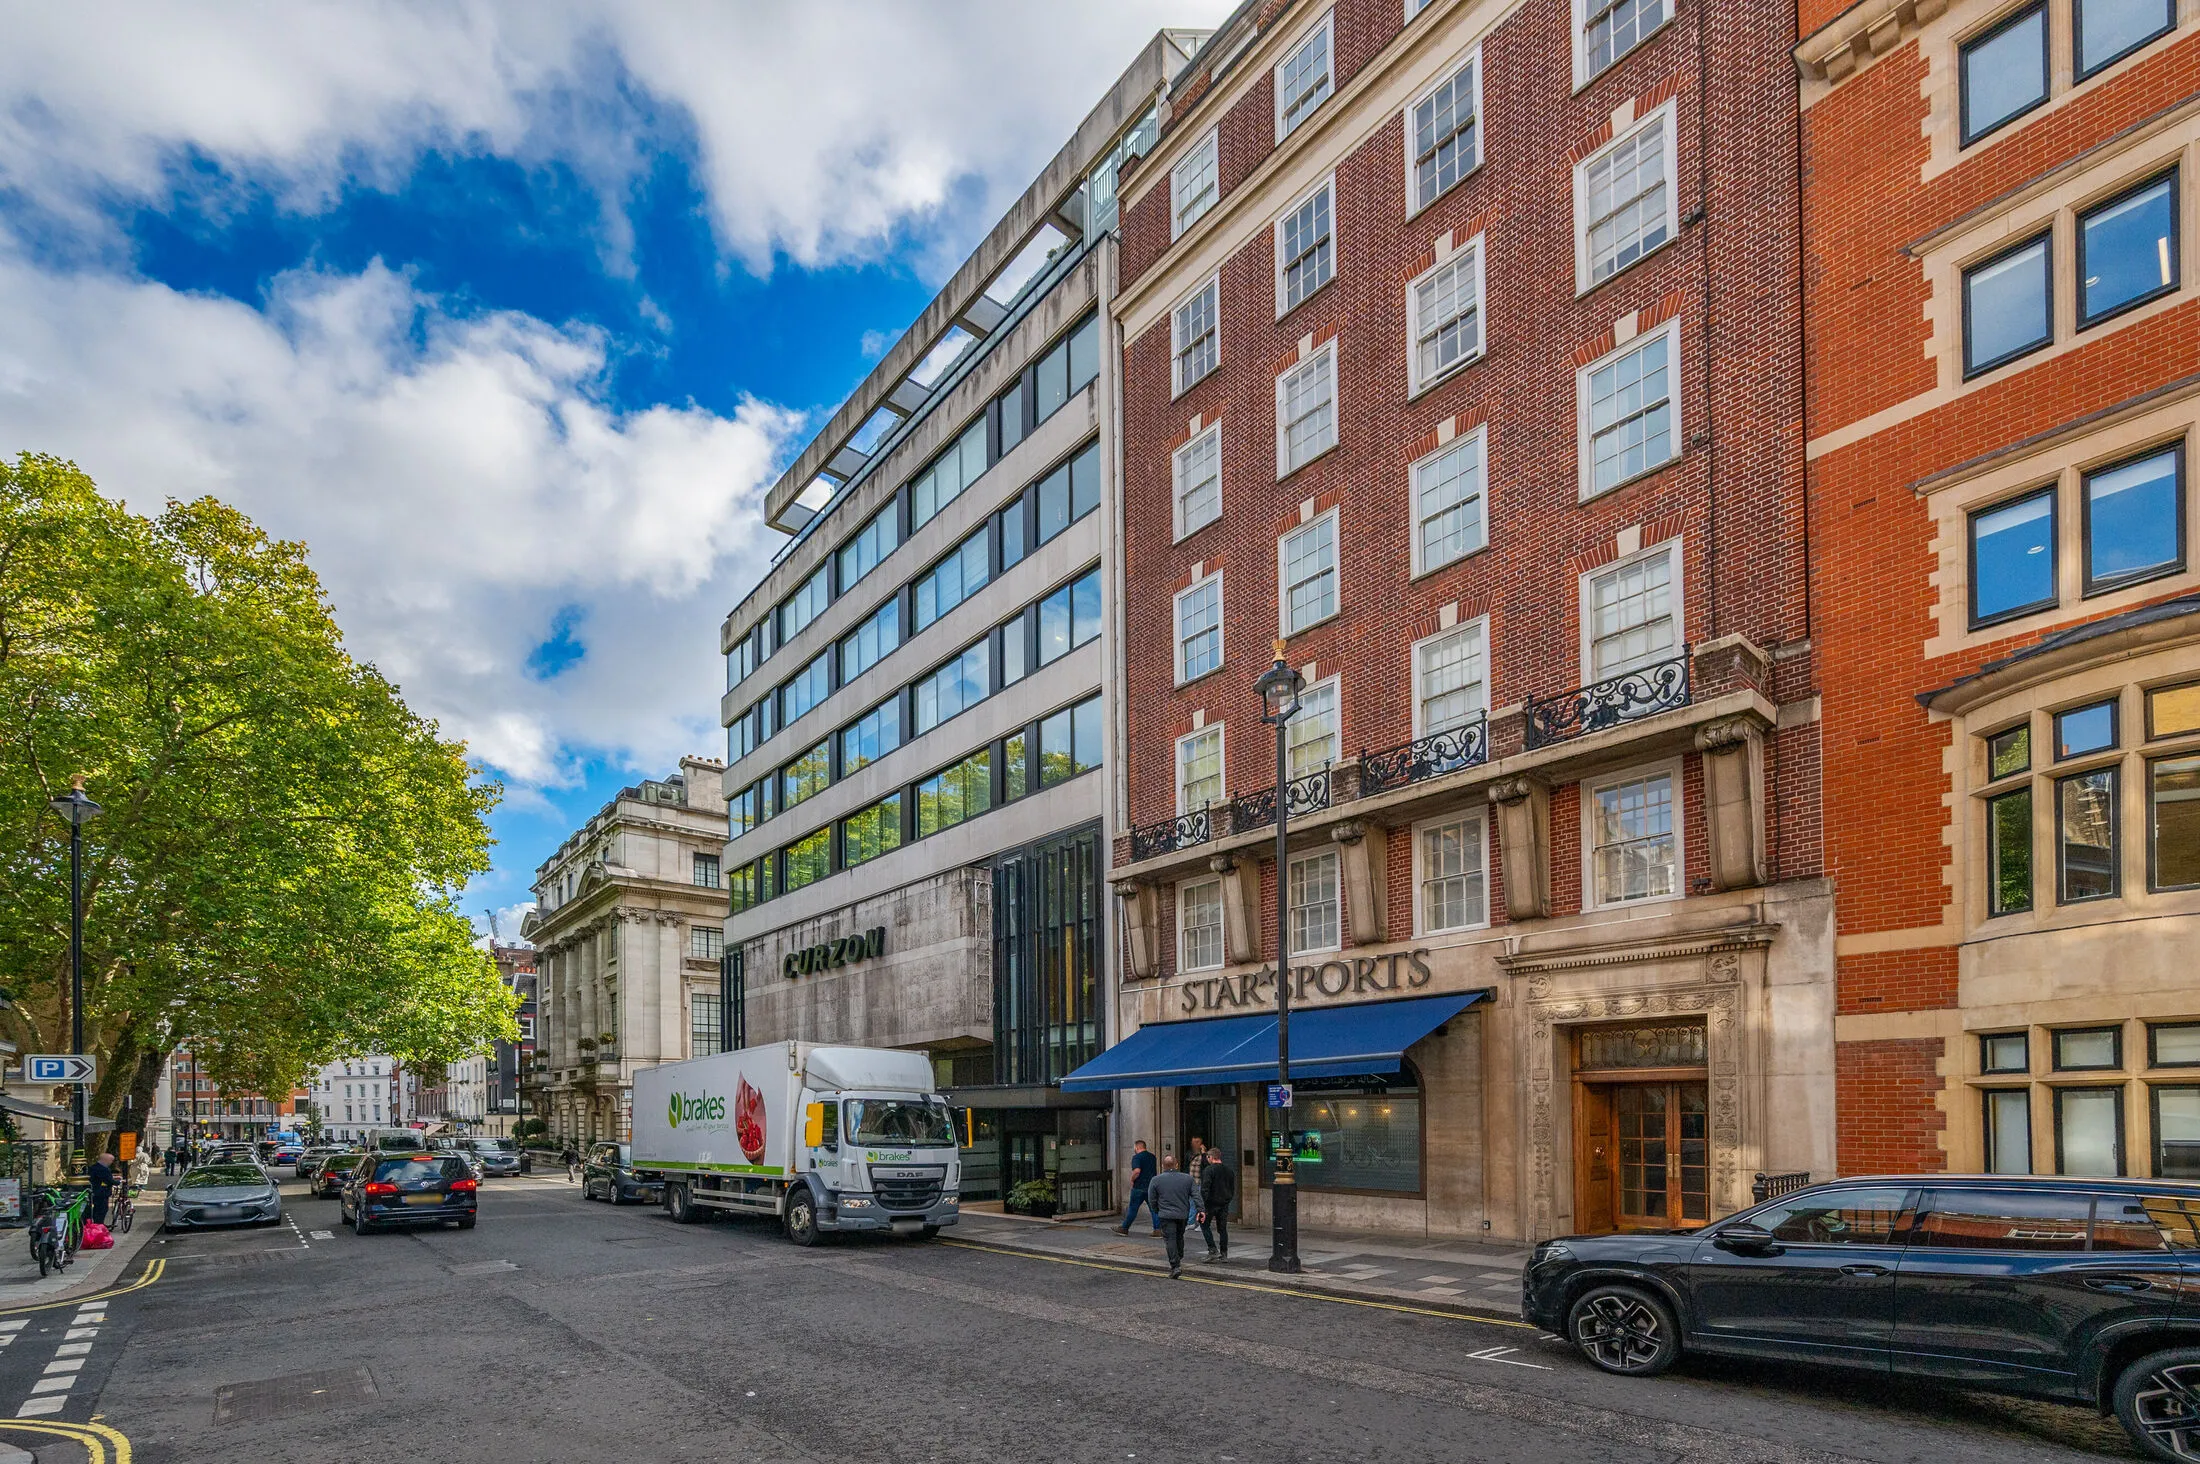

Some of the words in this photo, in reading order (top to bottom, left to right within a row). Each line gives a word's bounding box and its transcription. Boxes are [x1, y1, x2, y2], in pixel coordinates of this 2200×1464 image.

[783, 926, 885, 978] CURZON
[1181, 974, 1265, 1012] STAR
[42, 1062, 59, 1076] P
[683, 1089, 725, 1121] brakes
[879, 1151, 910, 1161] brakes
